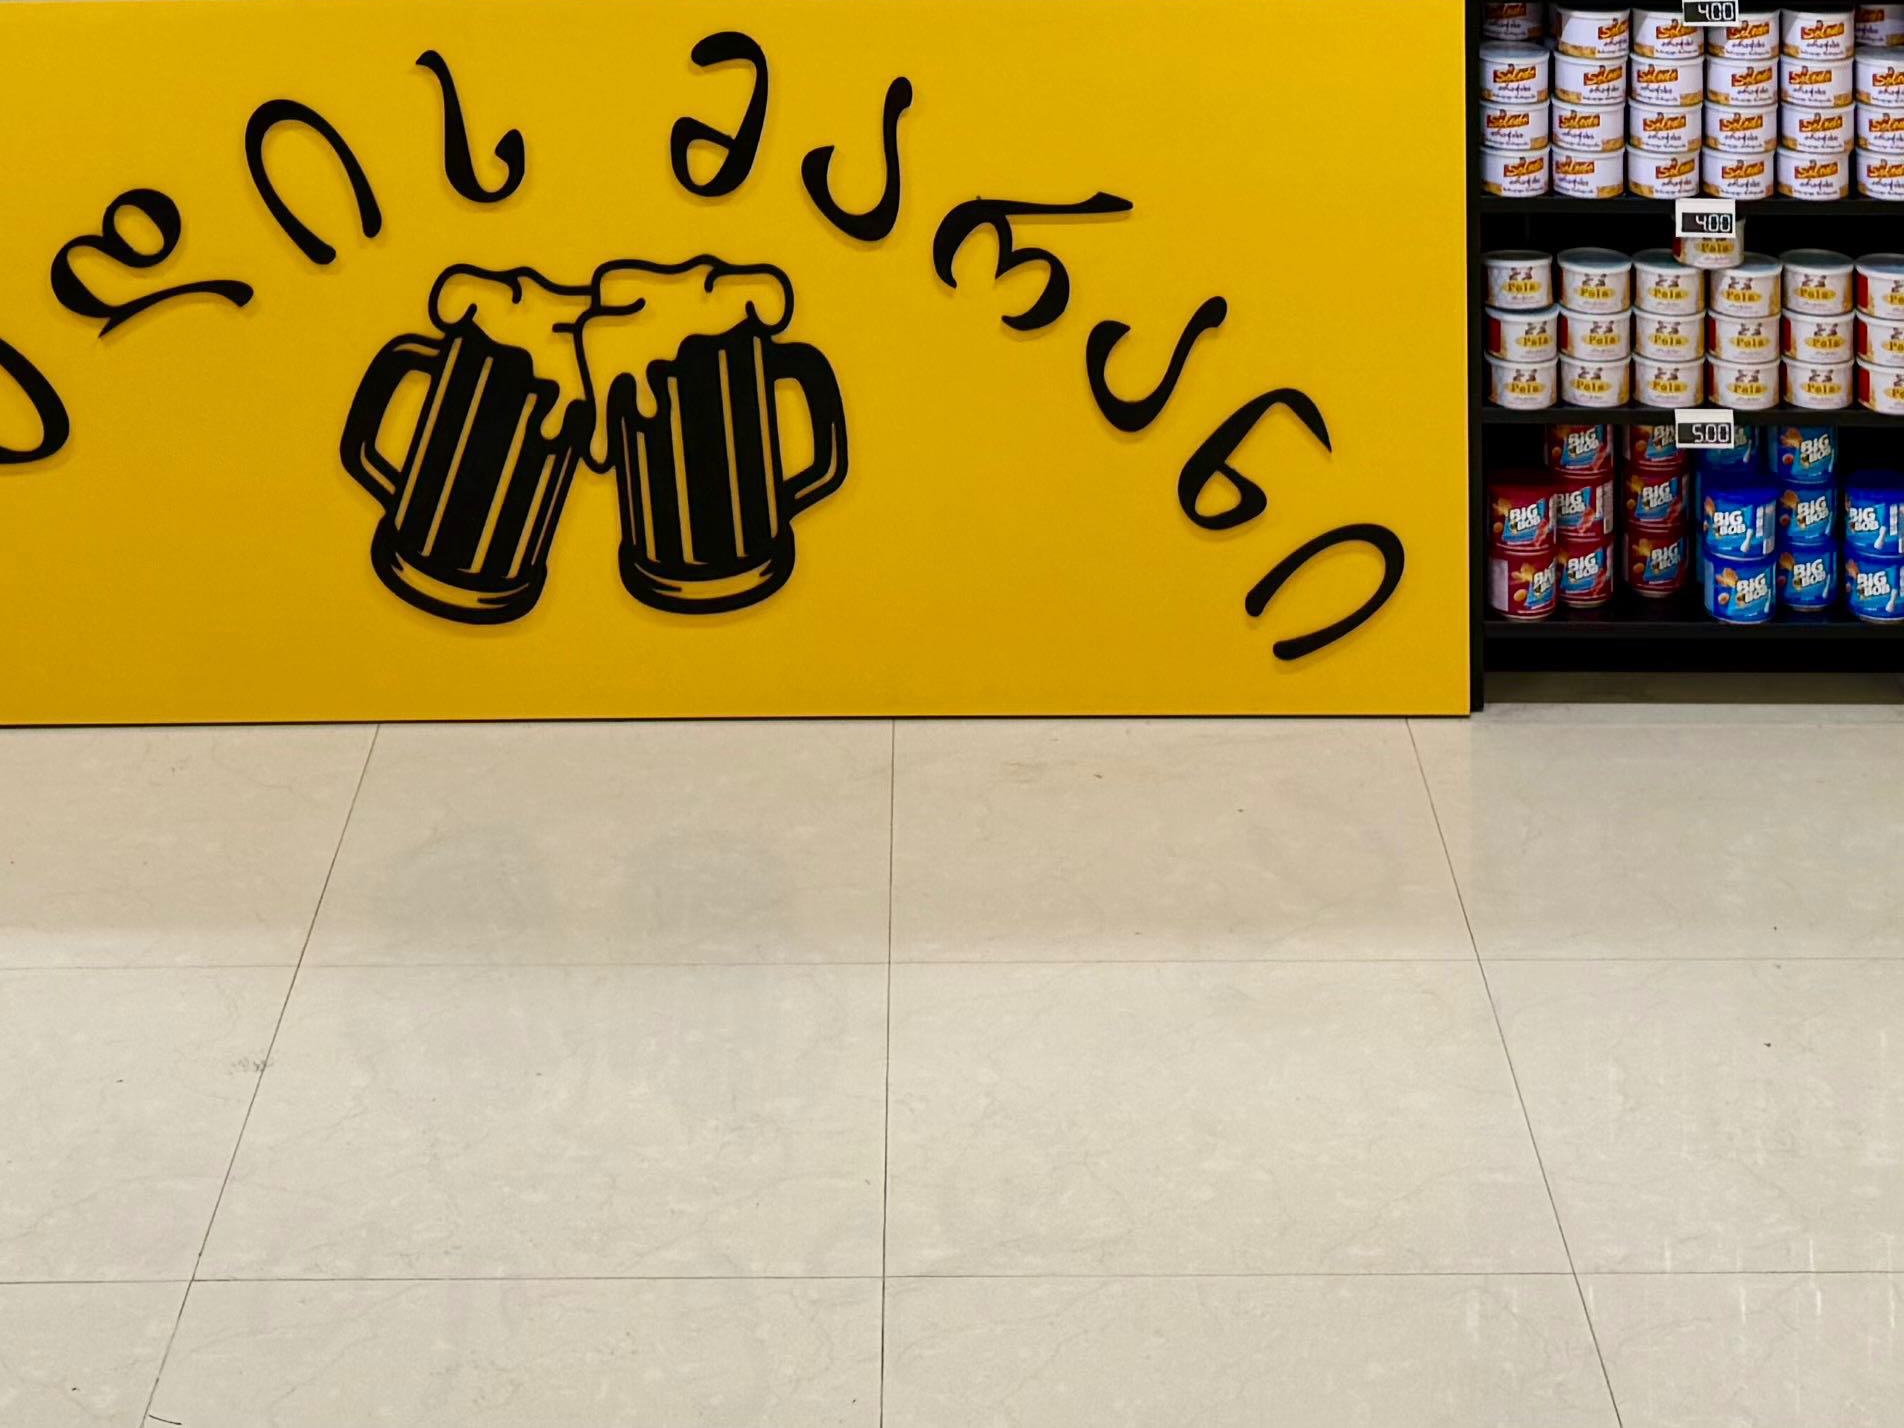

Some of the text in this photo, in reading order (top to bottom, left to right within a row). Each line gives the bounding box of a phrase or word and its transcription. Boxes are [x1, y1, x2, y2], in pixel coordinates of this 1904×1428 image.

[670, 32, 1405, 662] მარანი
[1568, 427, 1596, 445] BIG
[1801, 433, 1830, 453] BIG
[1643, 482, 1671, 499] BIG
[1509, 503, 1538, 521] BIG
[1798, 496, 1826, 514] BIG
[1714, 510, 1743, 526] BIG
[1849, 507, 1876, 522] BIG
[1568, 552, 1596, 570] BIG
[1794, 559, 1824, 576] BIG
[1736, 573, 1766, 591] BIG
[1857, 571, 1887, 587] BIG
